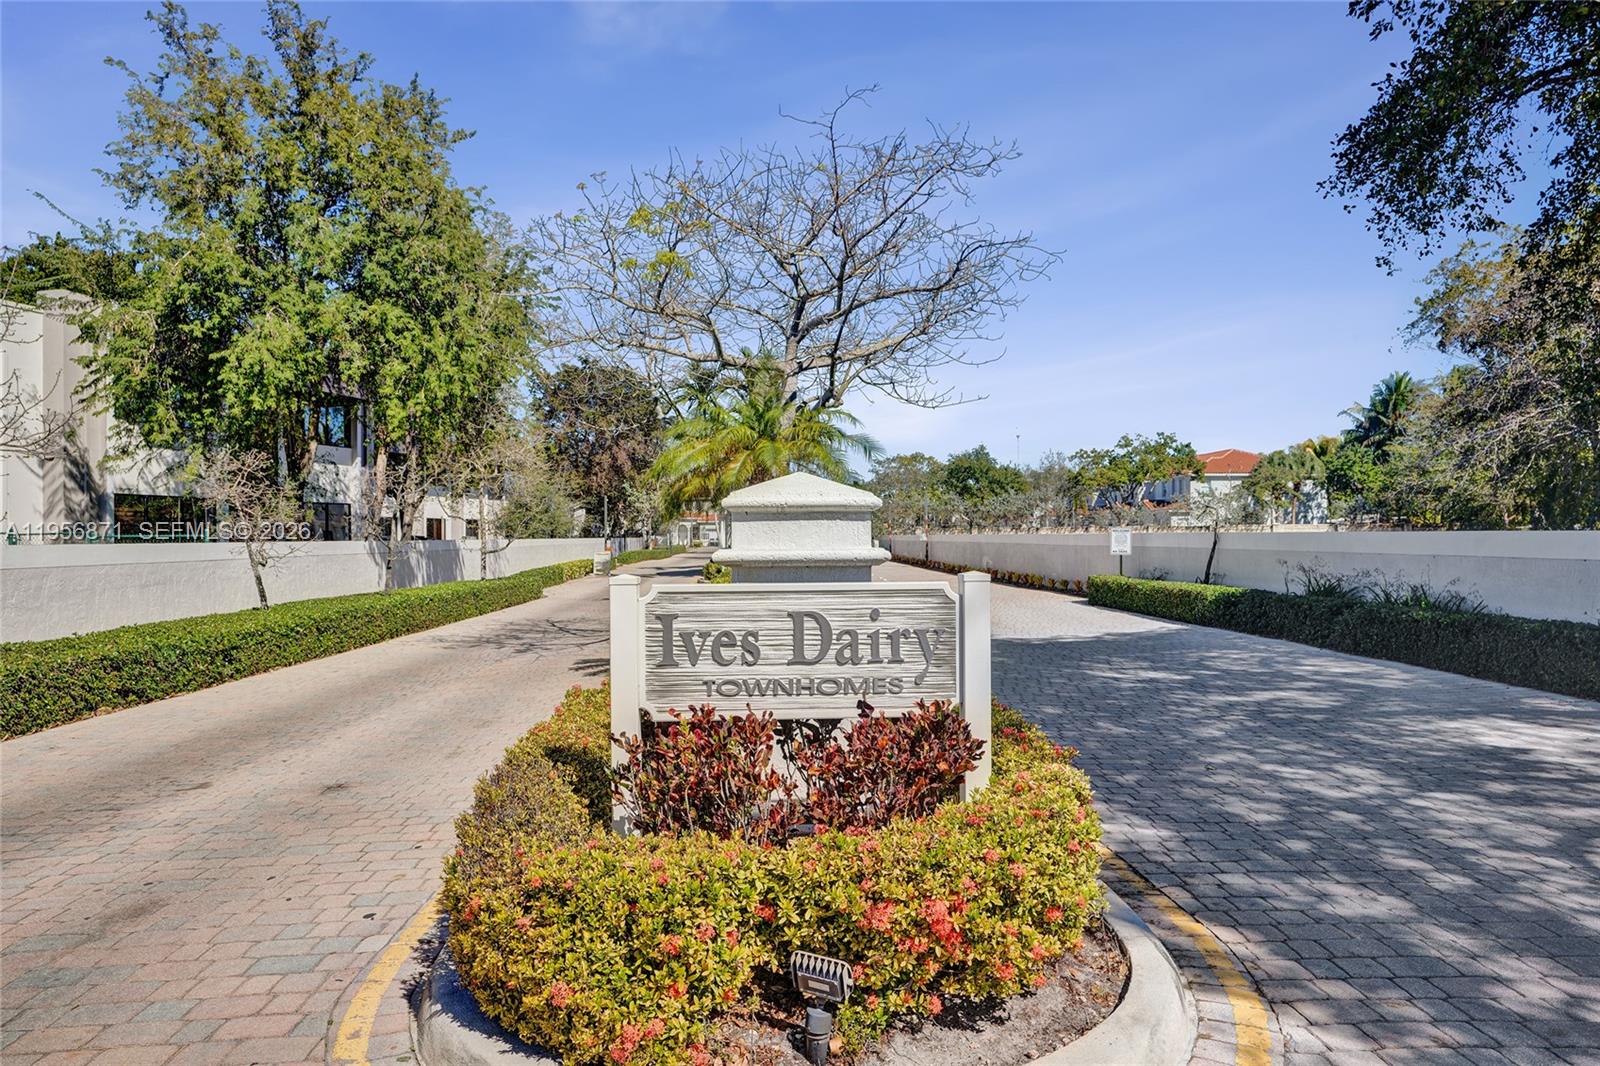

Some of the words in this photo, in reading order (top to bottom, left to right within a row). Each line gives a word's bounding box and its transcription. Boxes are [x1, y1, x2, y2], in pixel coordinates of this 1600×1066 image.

[654, 613, 761, 667] Ives
[788, 608, 944, 685] Dairy
[703, 677, 904, 697] TOWNHOMES
